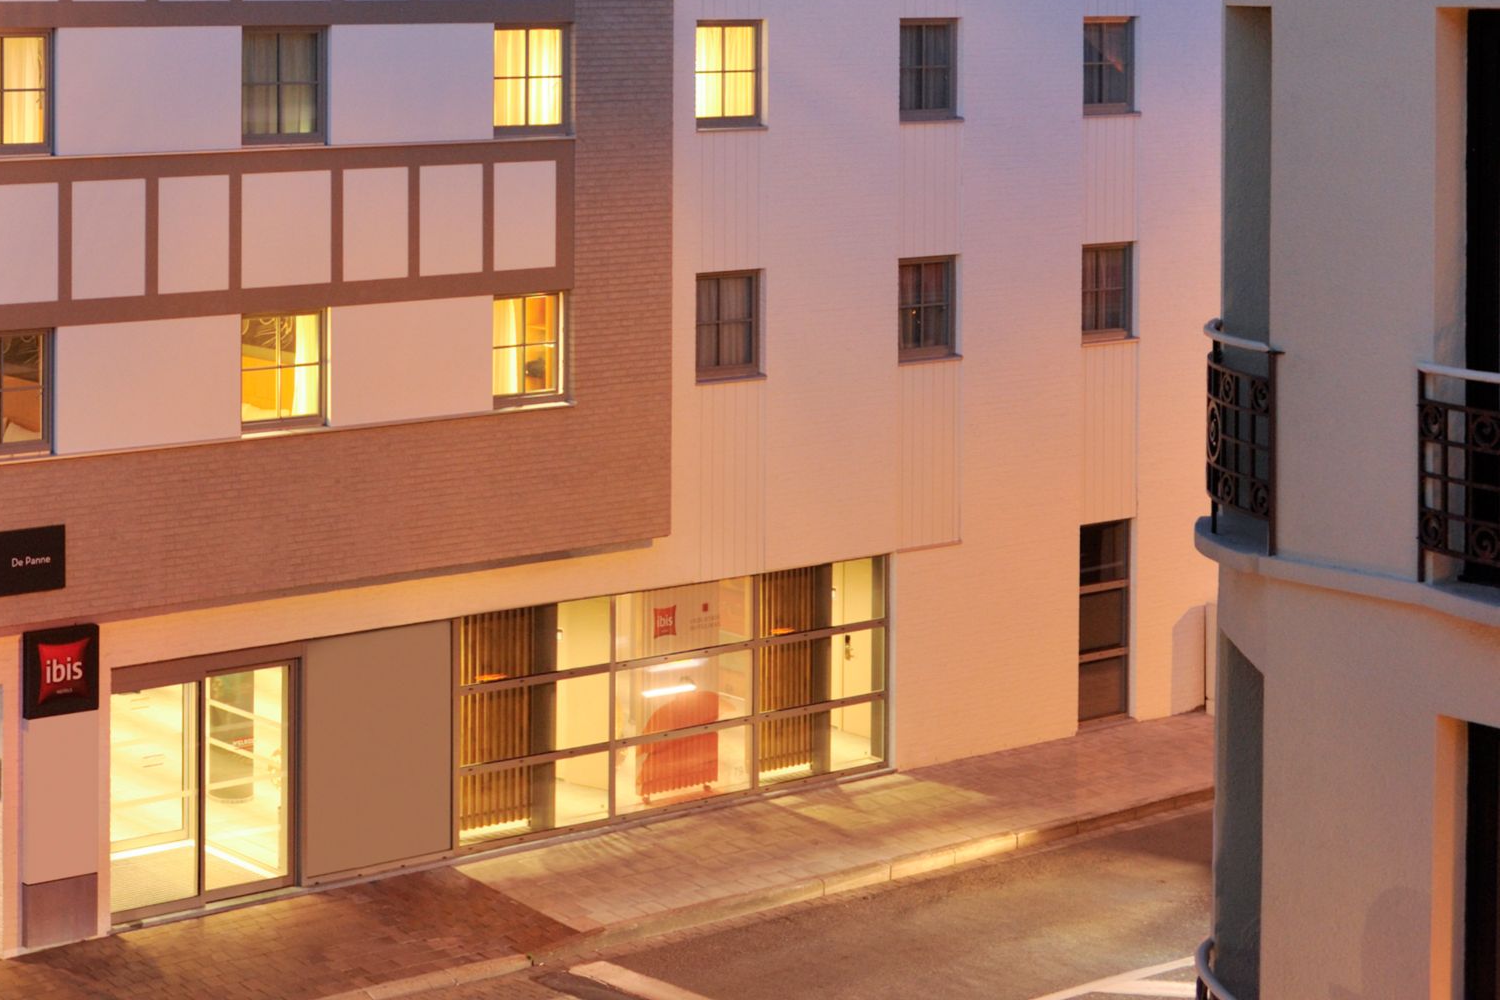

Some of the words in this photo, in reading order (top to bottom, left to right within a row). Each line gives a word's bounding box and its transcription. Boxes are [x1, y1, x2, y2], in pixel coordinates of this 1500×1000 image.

[11, 557, 23, 568] De
[25, 556, 51, 566] Panne
[657, 614, 673, 627] ibis
[46, 656, 83, 684] ibis
